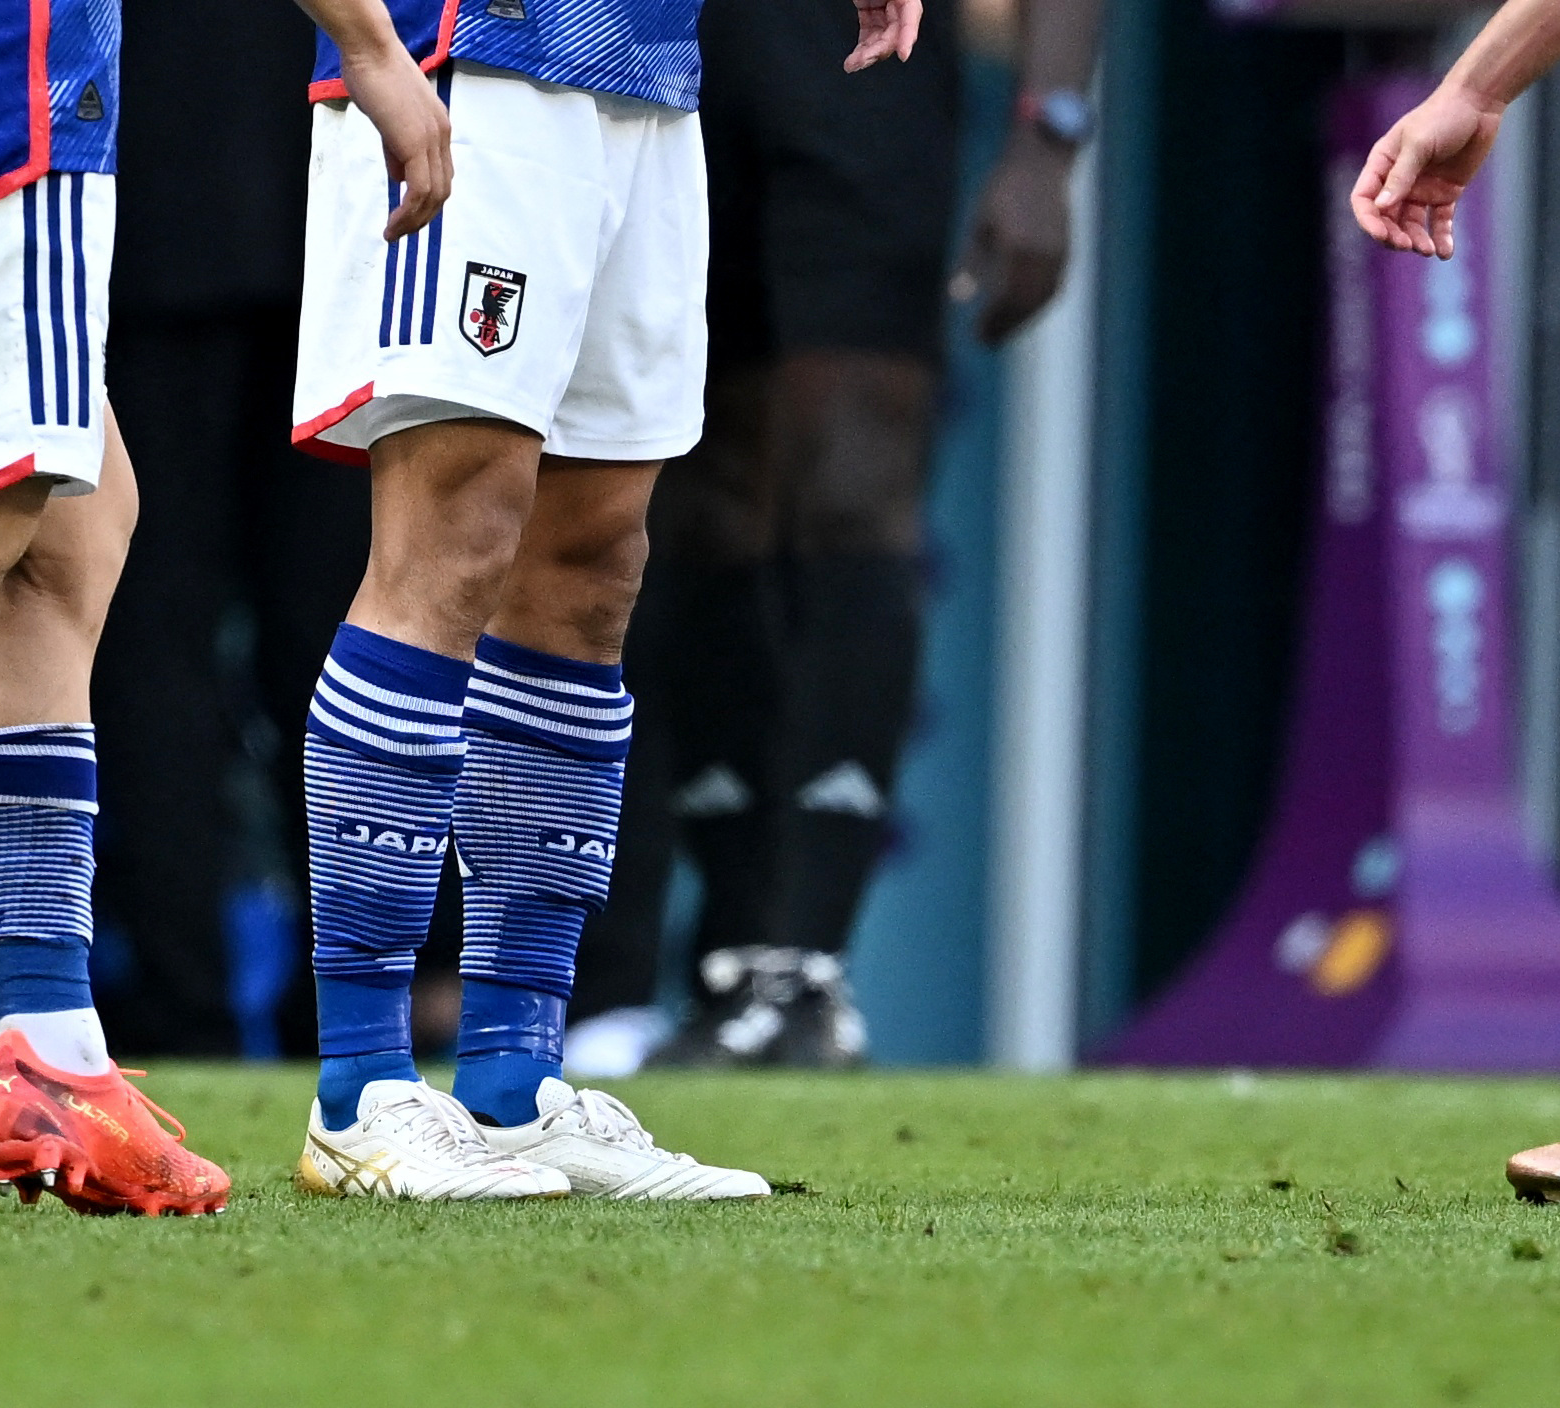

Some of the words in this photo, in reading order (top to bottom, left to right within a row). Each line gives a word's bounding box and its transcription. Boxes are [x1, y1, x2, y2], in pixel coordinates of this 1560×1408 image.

[480, 265, 514, 281] JAPAN
[473, 324, 501, 345] JFA
[67, 1094, 129, 1143] ULTRA
